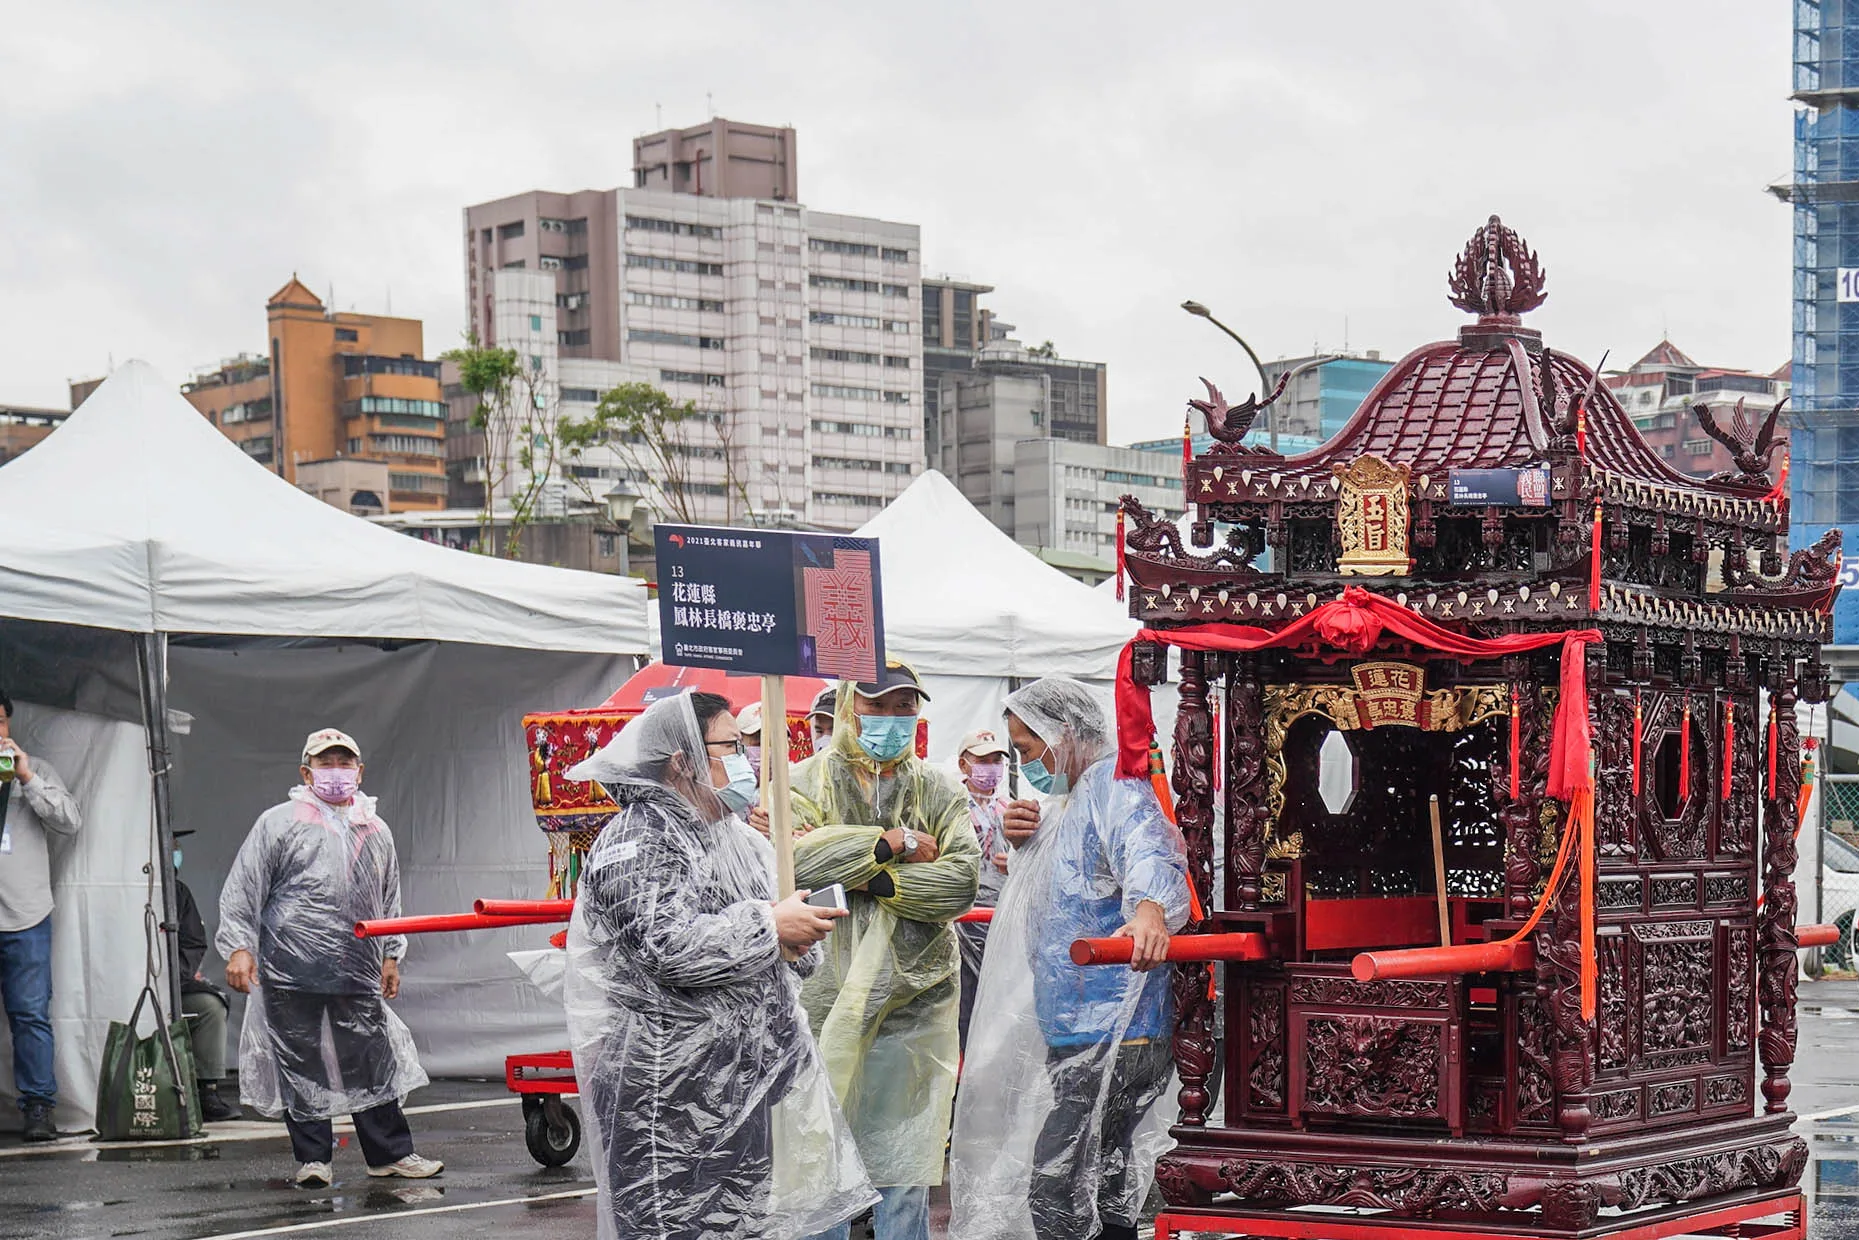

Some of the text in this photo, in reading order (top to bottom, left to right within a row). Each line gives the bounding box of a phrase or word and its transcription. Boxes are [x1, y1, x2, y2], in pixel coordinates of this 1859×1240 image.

[1365, 495, 1385, 550] 玉旨
[671, 565, 685, 578] 13
[1840, 558, 1859, 587] 5
[672, 581, 717, 605] 花蓮縣
[673, 606, 777, 634] 鳳林長橋褒忠亭
